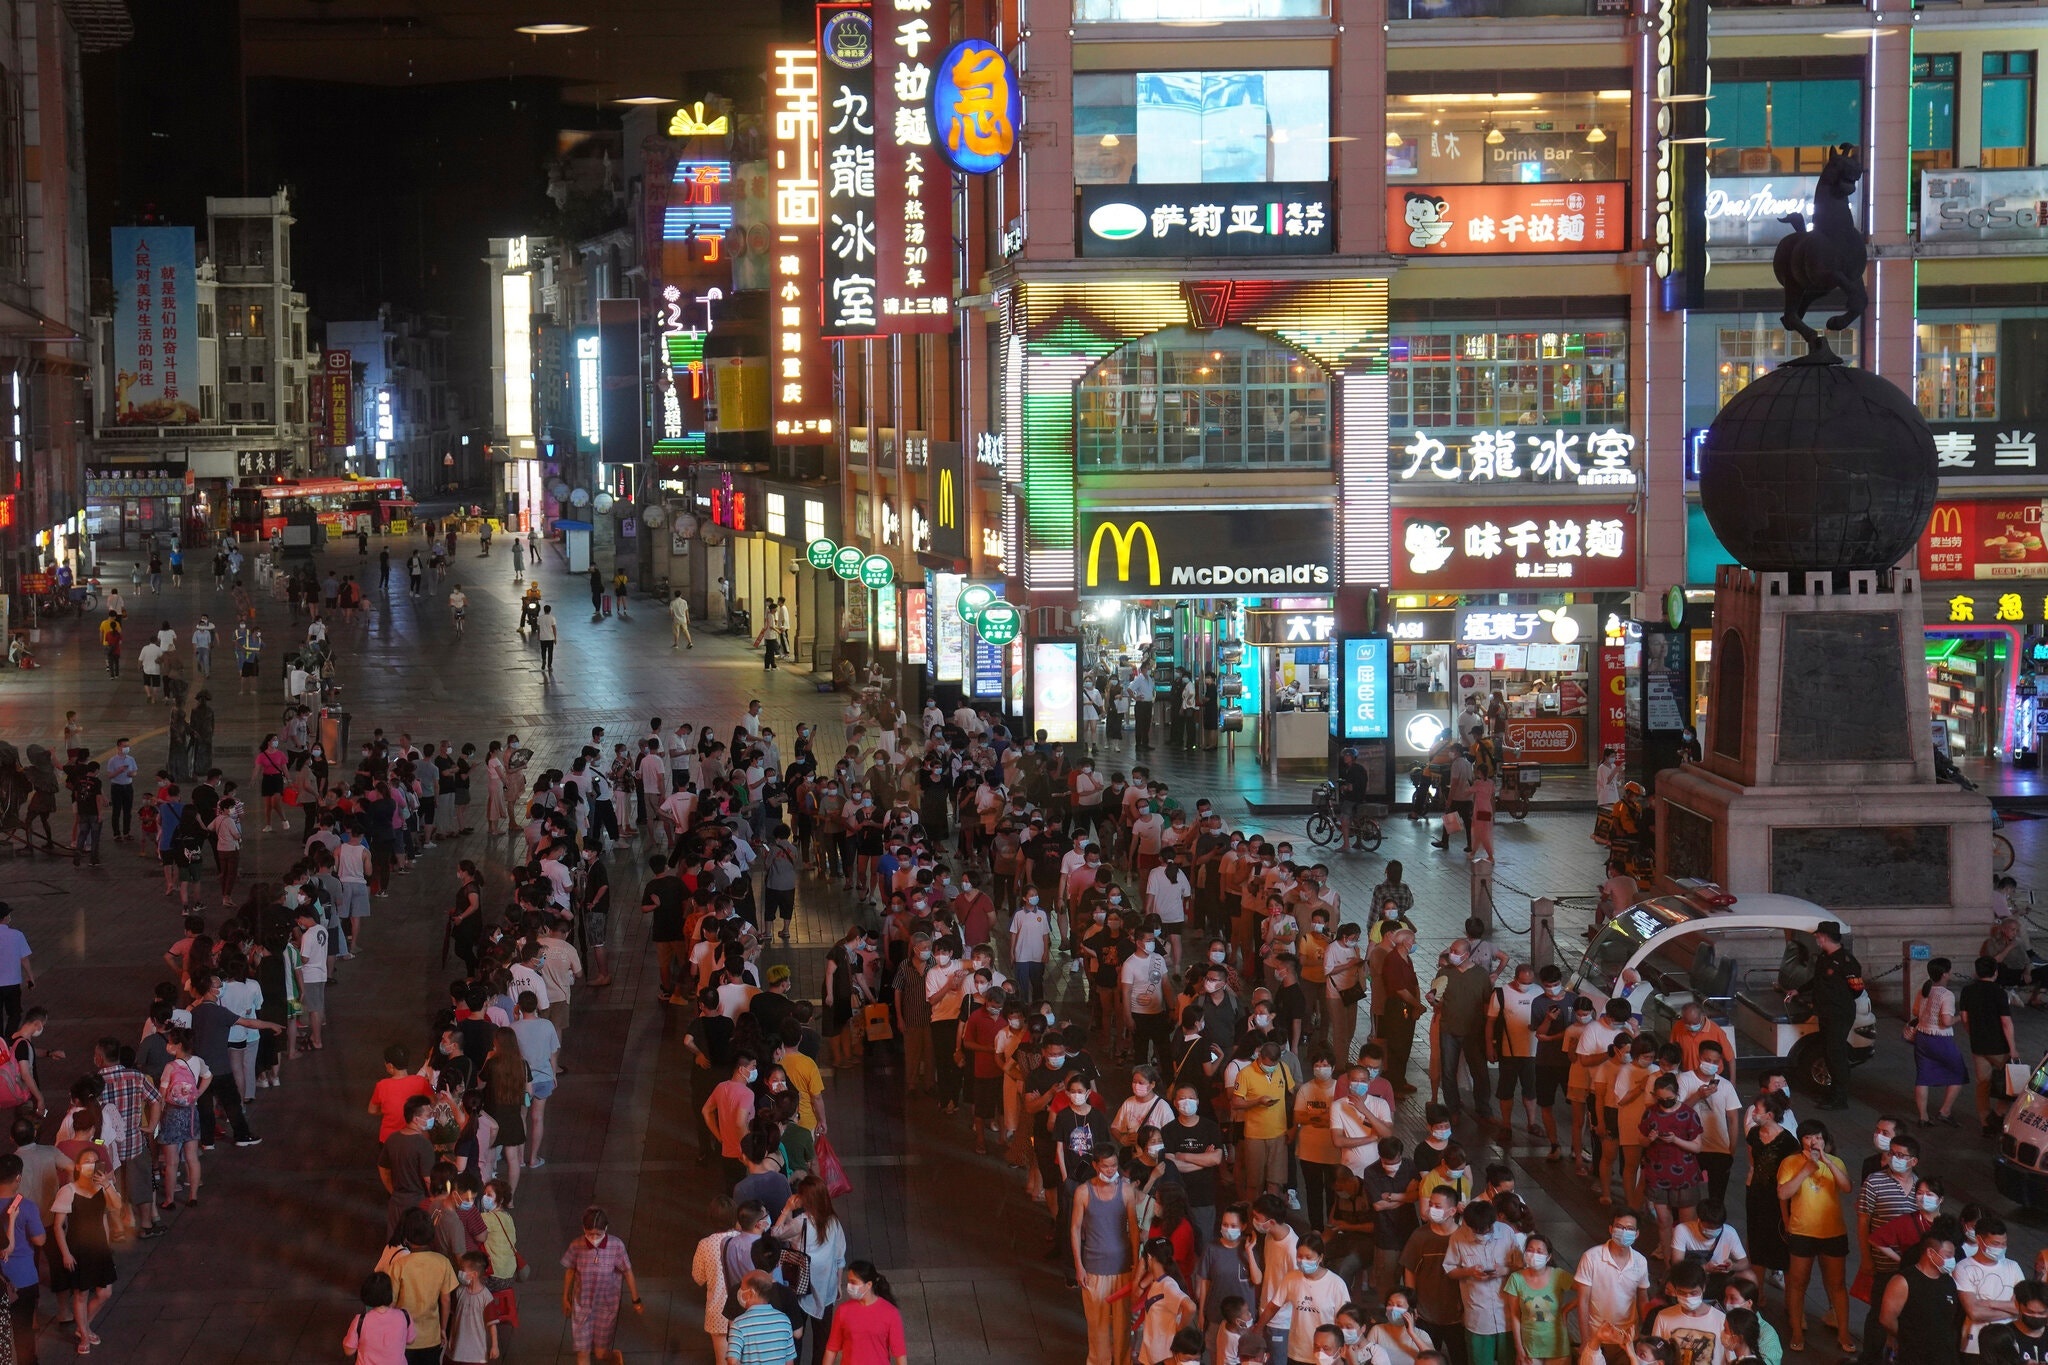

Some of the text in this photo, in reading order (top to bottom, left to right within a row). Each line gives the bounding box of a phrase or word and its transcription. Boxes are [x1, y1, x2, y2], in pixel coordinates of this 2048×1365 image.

[1493, 147, 1573, 161] Drink Bar
[829, 85, 876, 327] 九龍冰室
[1285, 202, 1325, 219] 意式
[1151, 203, 1264, 238] 萨莉亚
[1595, 194, 1606, 240] 请上三楼
[1285, 219, 1325, 236] 餐厅
[136, 239, 153, 387] 人民对美好生活的向往
[882, 297, 948, 315] 请上三楼
[160, 266, 178, 400] 就是我们的奋斗目标
[1400, 428, 1636, 481] 九龍冰室
[1933, 430, 2037, 468] 麦当
[1930, 536, 1963, 548] 麦当劳
[1930, 553, 1963, 563] 餐厅位于
[1171, 563, 1329, 585] McDonald's
[1949, 593, 2048, 622] 东急
[1609, 707, 1625, 720] 16
[1526, 730, 1569, 739] ORANGE
[1531, 739, 1567, 748] HOUSE
